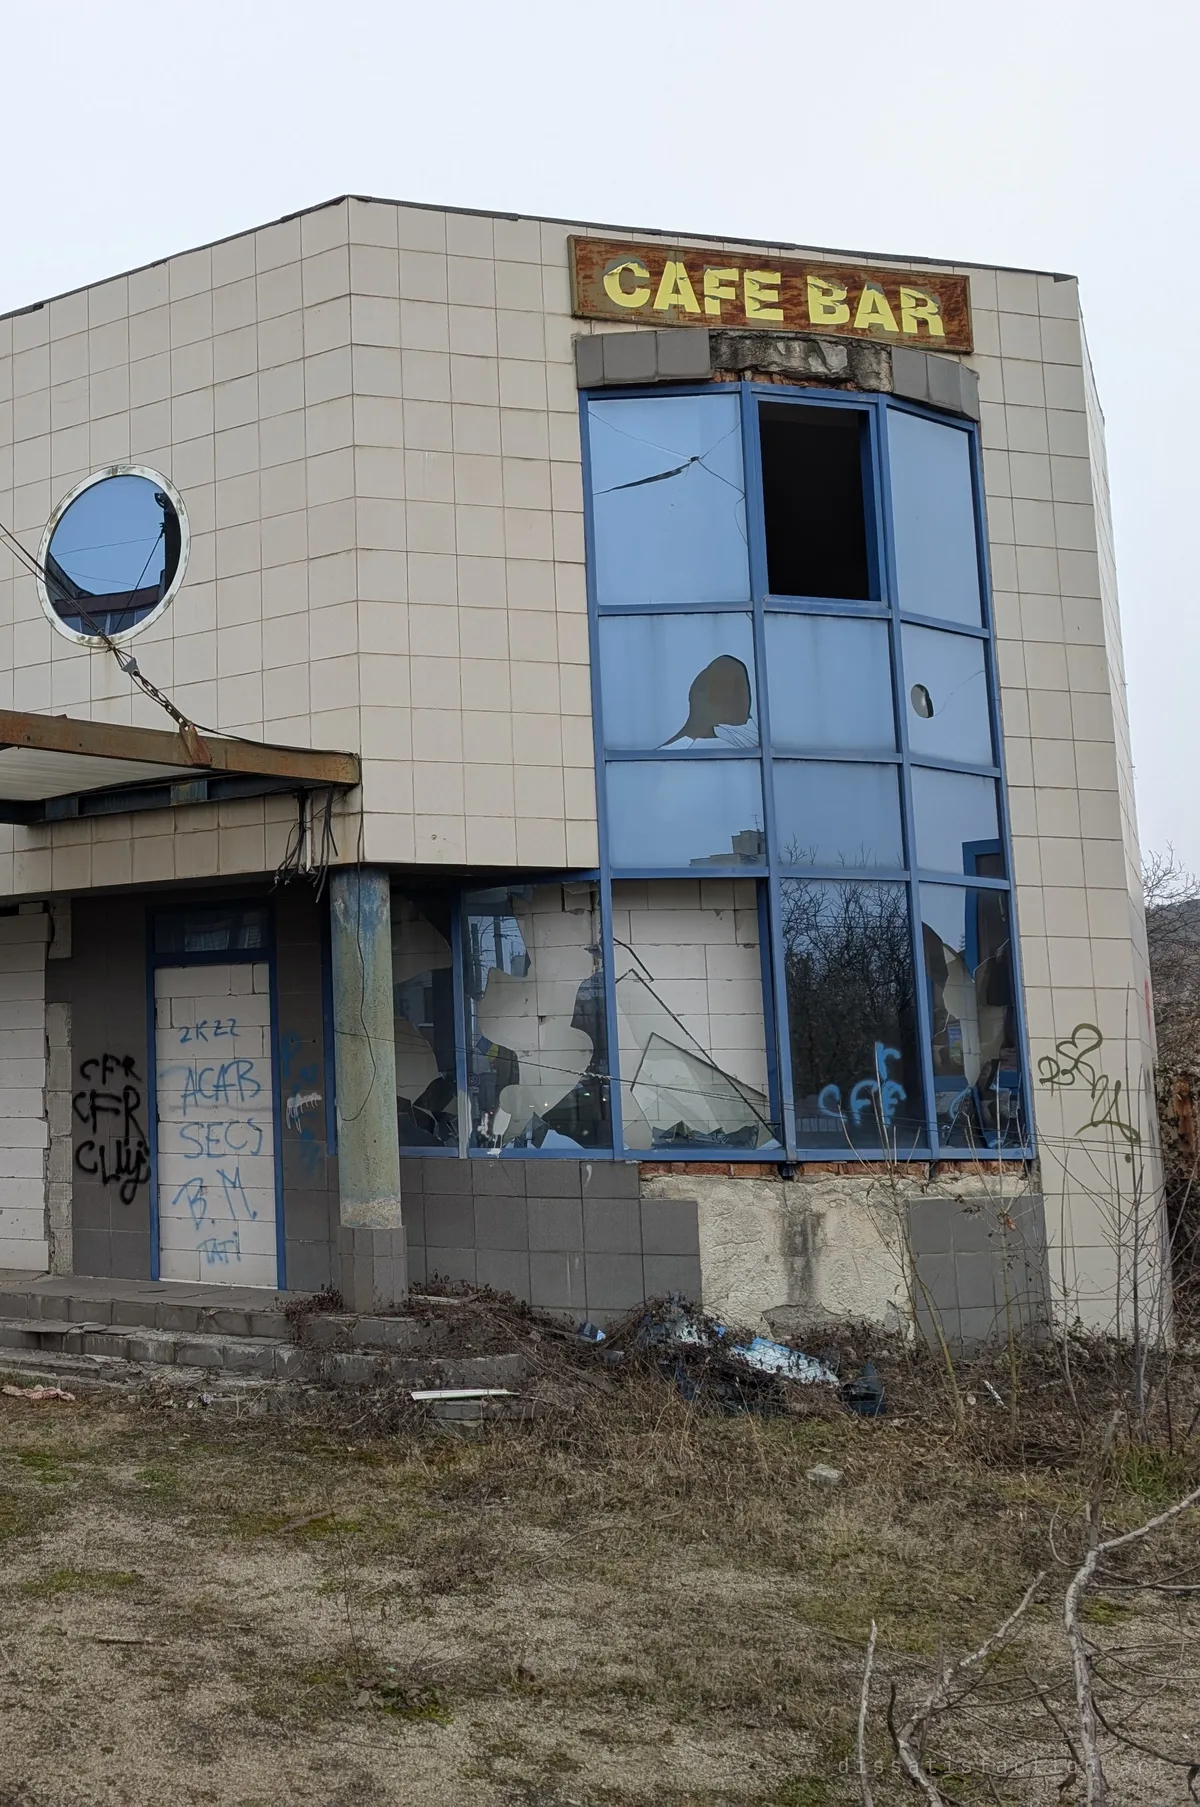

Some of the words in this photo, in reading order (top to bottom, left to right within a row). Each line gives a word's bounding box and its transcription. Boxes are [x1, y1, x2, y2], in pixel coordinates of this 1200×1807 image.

[603, 261, 784, 321] CAFE
[806, 275, 946, 336] BAR
[80, 1053, 142, 1085] CFR
[181, 1060, 261, 1116] ACAB
[72, 1085, 150, 1155] CFR
